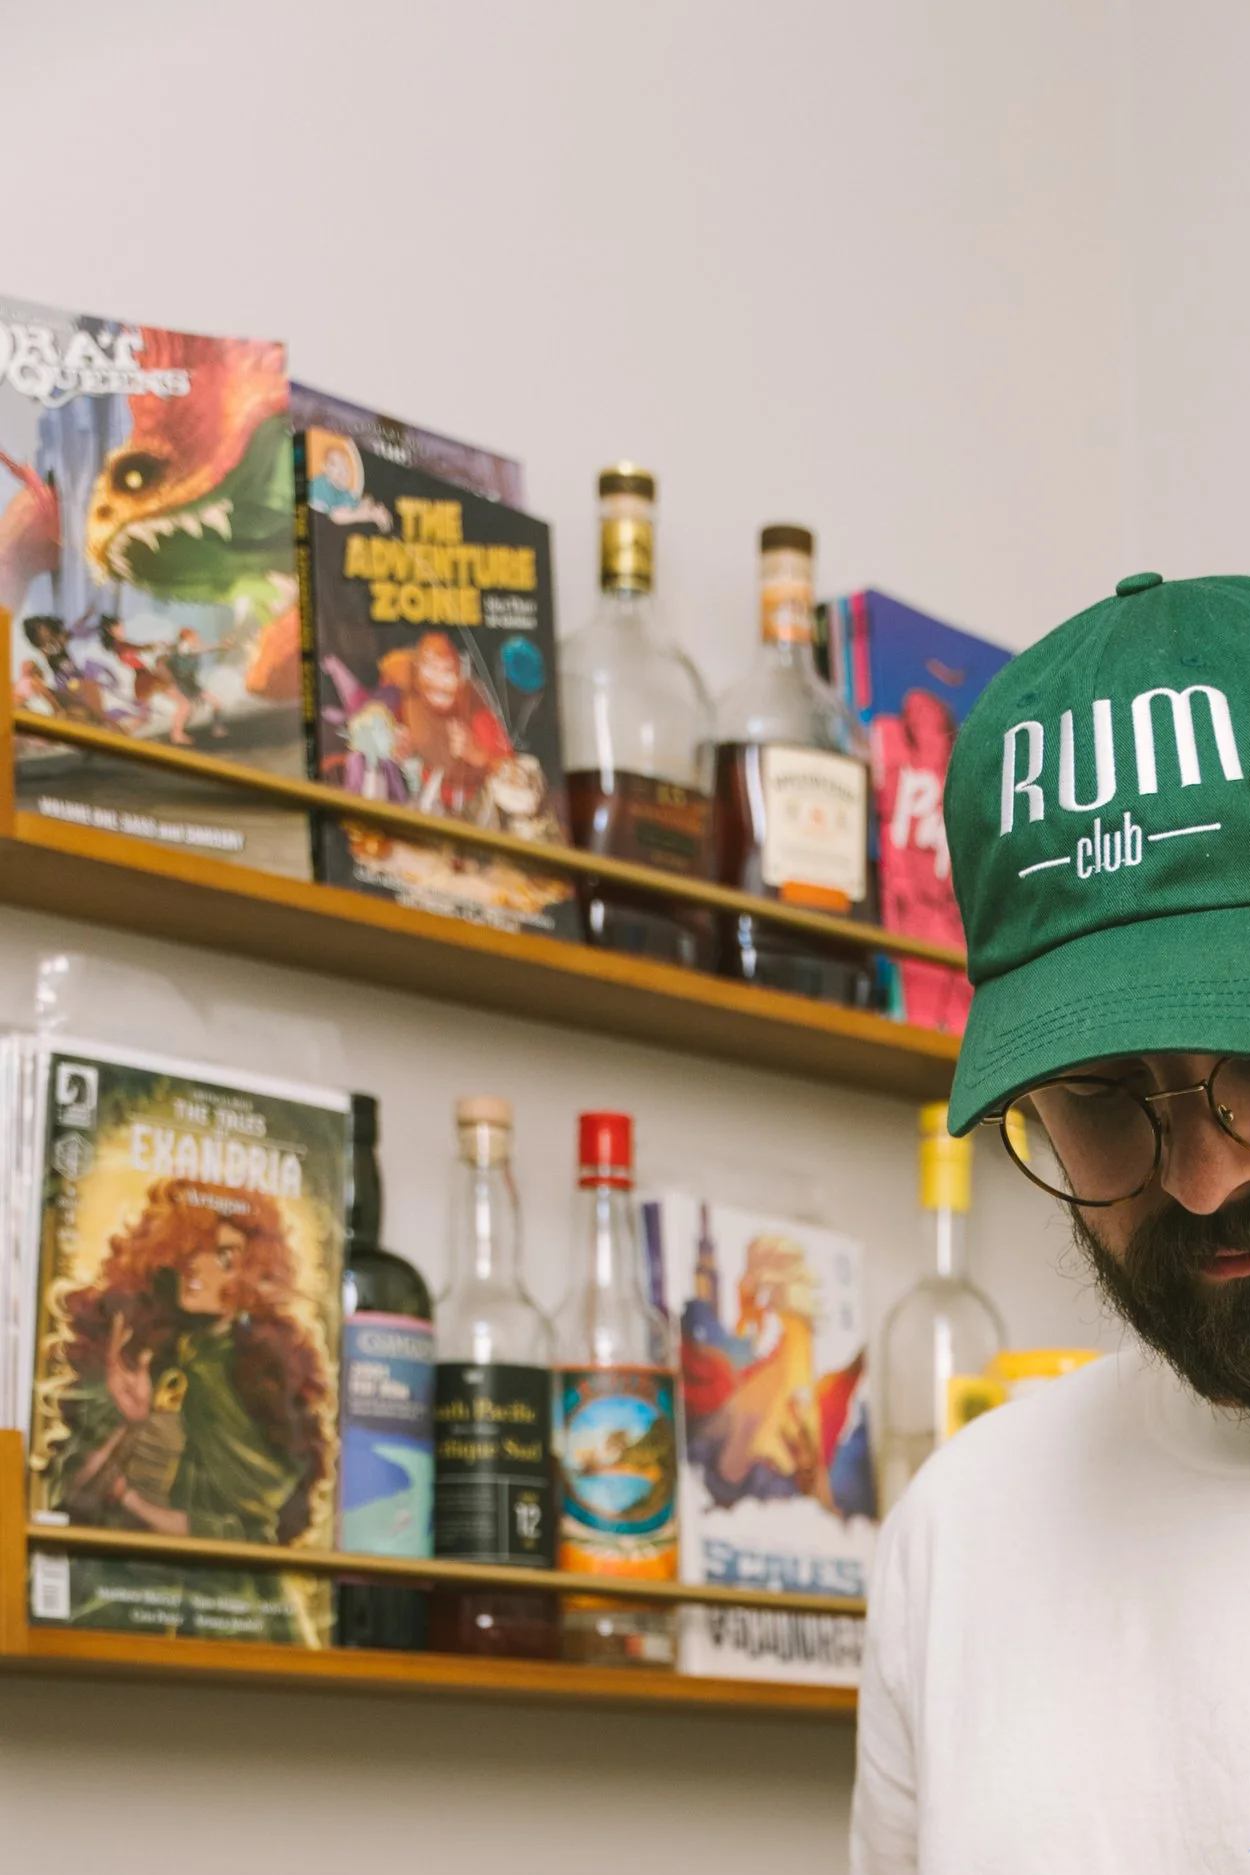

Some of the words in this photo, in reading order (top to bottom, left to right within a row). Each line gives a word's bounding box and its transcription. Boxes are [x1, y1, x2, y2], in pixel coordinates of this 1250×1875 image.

[396, 496, 462, 543] THE
[344, 533, 537, 592] ADVENTURE
[370, 577, 483, 625] ZONE
[1001, 684, 1245, 838] RUM
[1076, 811, 1143, 879] club
[131, 1123, 304, 1200] EXANDRIA
